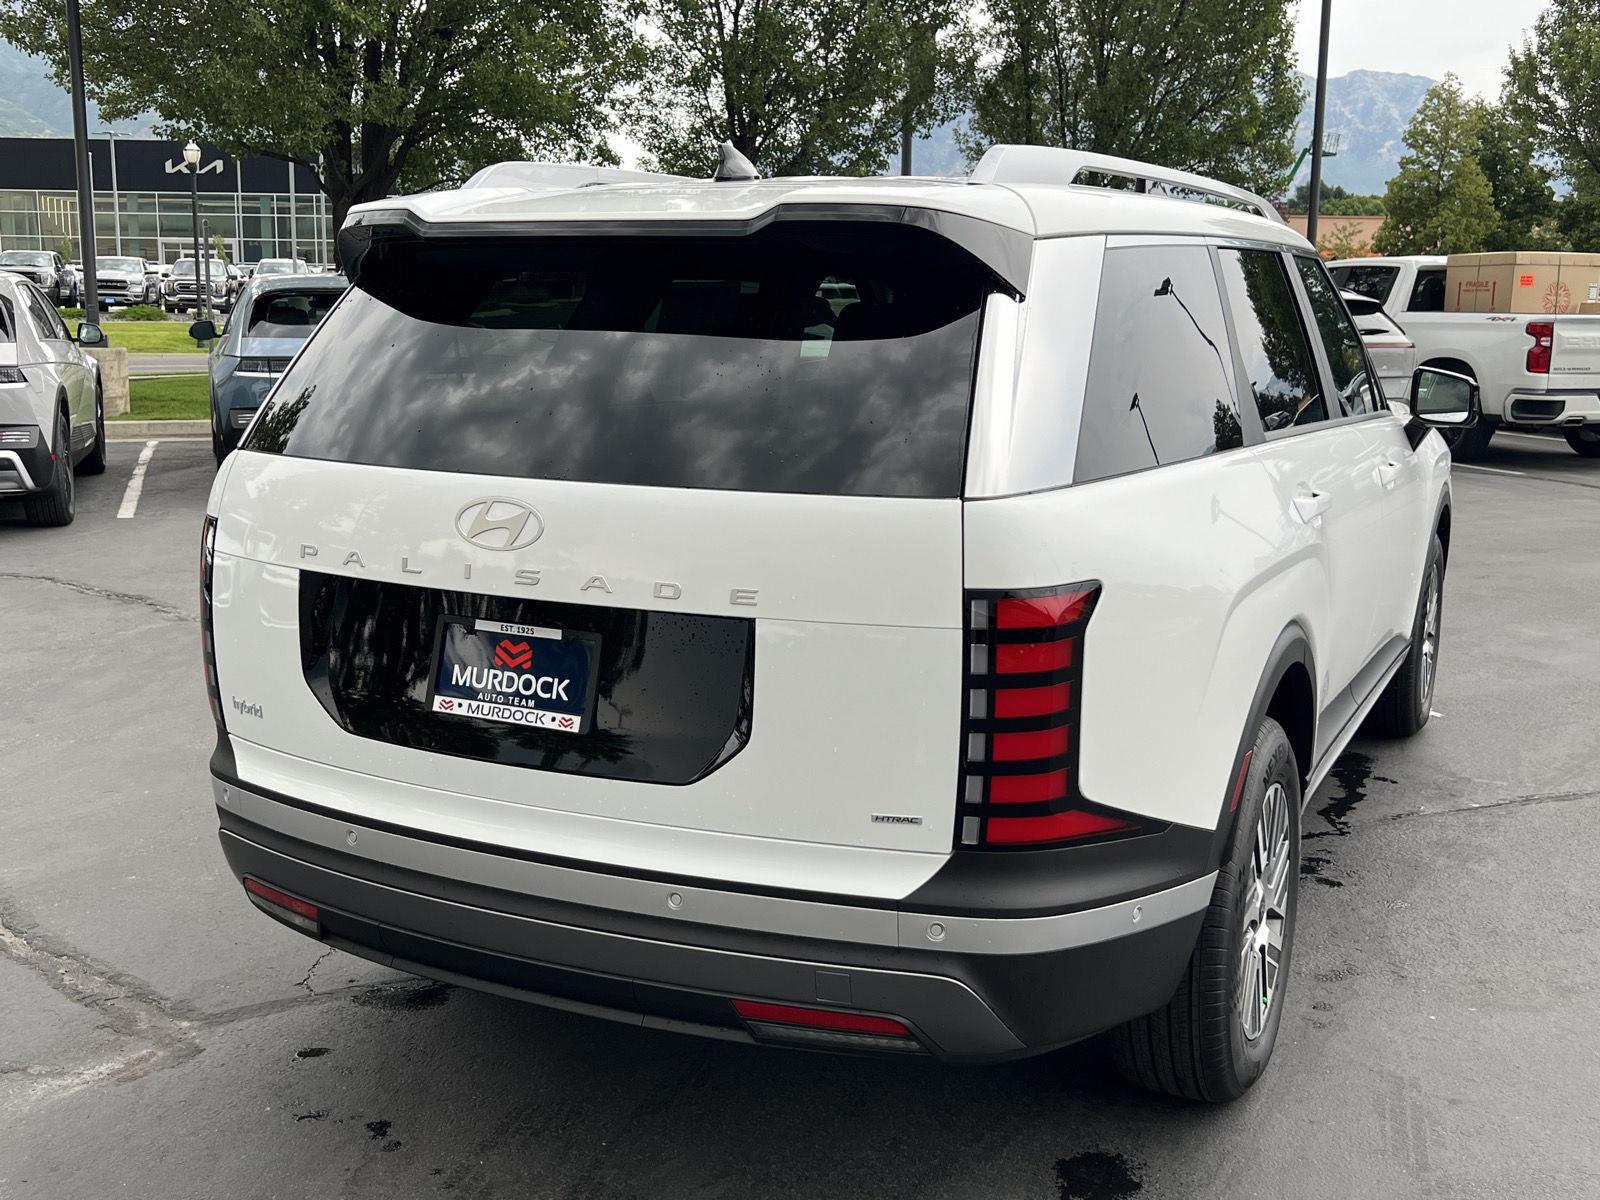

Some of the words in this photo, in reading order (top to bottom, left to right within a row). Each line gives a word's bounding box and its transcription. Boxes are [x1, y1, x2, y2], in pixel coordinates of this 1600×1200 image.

[1465, 280, 1489, 288] FRAGILE
[299, 544, 759, 606] PALISADE
[500, 624, 516, 633] EST.
[517, 626, 535, 636] 1925
[452, 664, 570, 701] MURDOCK
[232, 696, 263, 719] hybrid
[477, 692, 504, 704] AUTO
[508, 696, 536, 708] TEAM
[466, 702, 547, 726] MURDOCK
[874, 815, 920, 824] HTRAC
